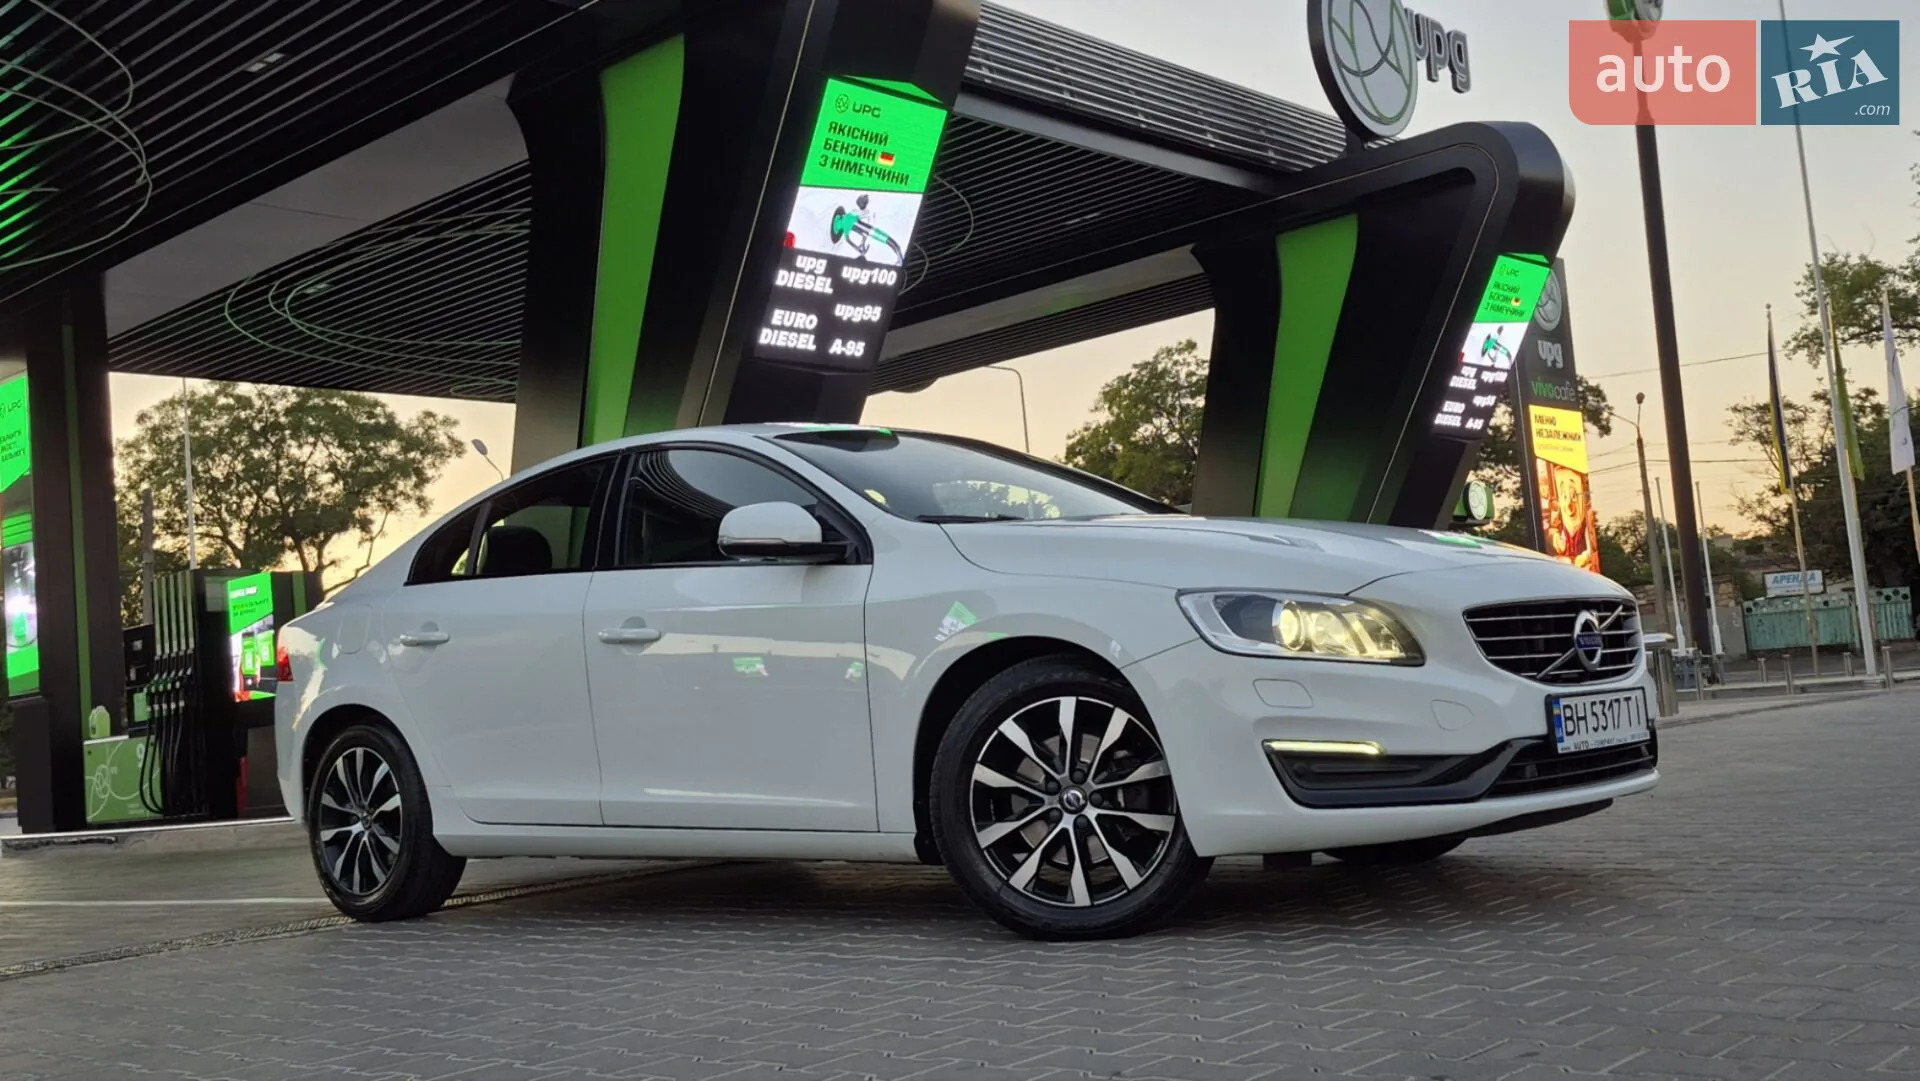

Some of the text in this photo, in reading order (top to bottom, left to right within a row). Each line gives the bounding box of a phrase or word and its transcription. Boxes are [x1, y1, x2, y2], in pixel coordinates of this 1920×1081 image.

[852, 102, 882, 118] UPG
[828, 121, 889, 146] ЯКІСНИЙ
[823, 137, 878, 161] БЕНЗИН
[830, 156, 910, 186] НІМЕЧЧИНИ
[795, 254, 827, 275] upg
[841, 265, 898, 286] upg100
[775, 269, 834, 294] DIESEL
[771, 308, 818, 330] EURO
[834, 303, 882, 323] upg95
[758, 328, 817, 351] DIESEL
[829, 338, 866, 357] A-95
[1537, 340, 1563, 368] upg
[1772, 573, 1816, 584] АРЕНА
[1590, 698, 1621, 732] 5317
